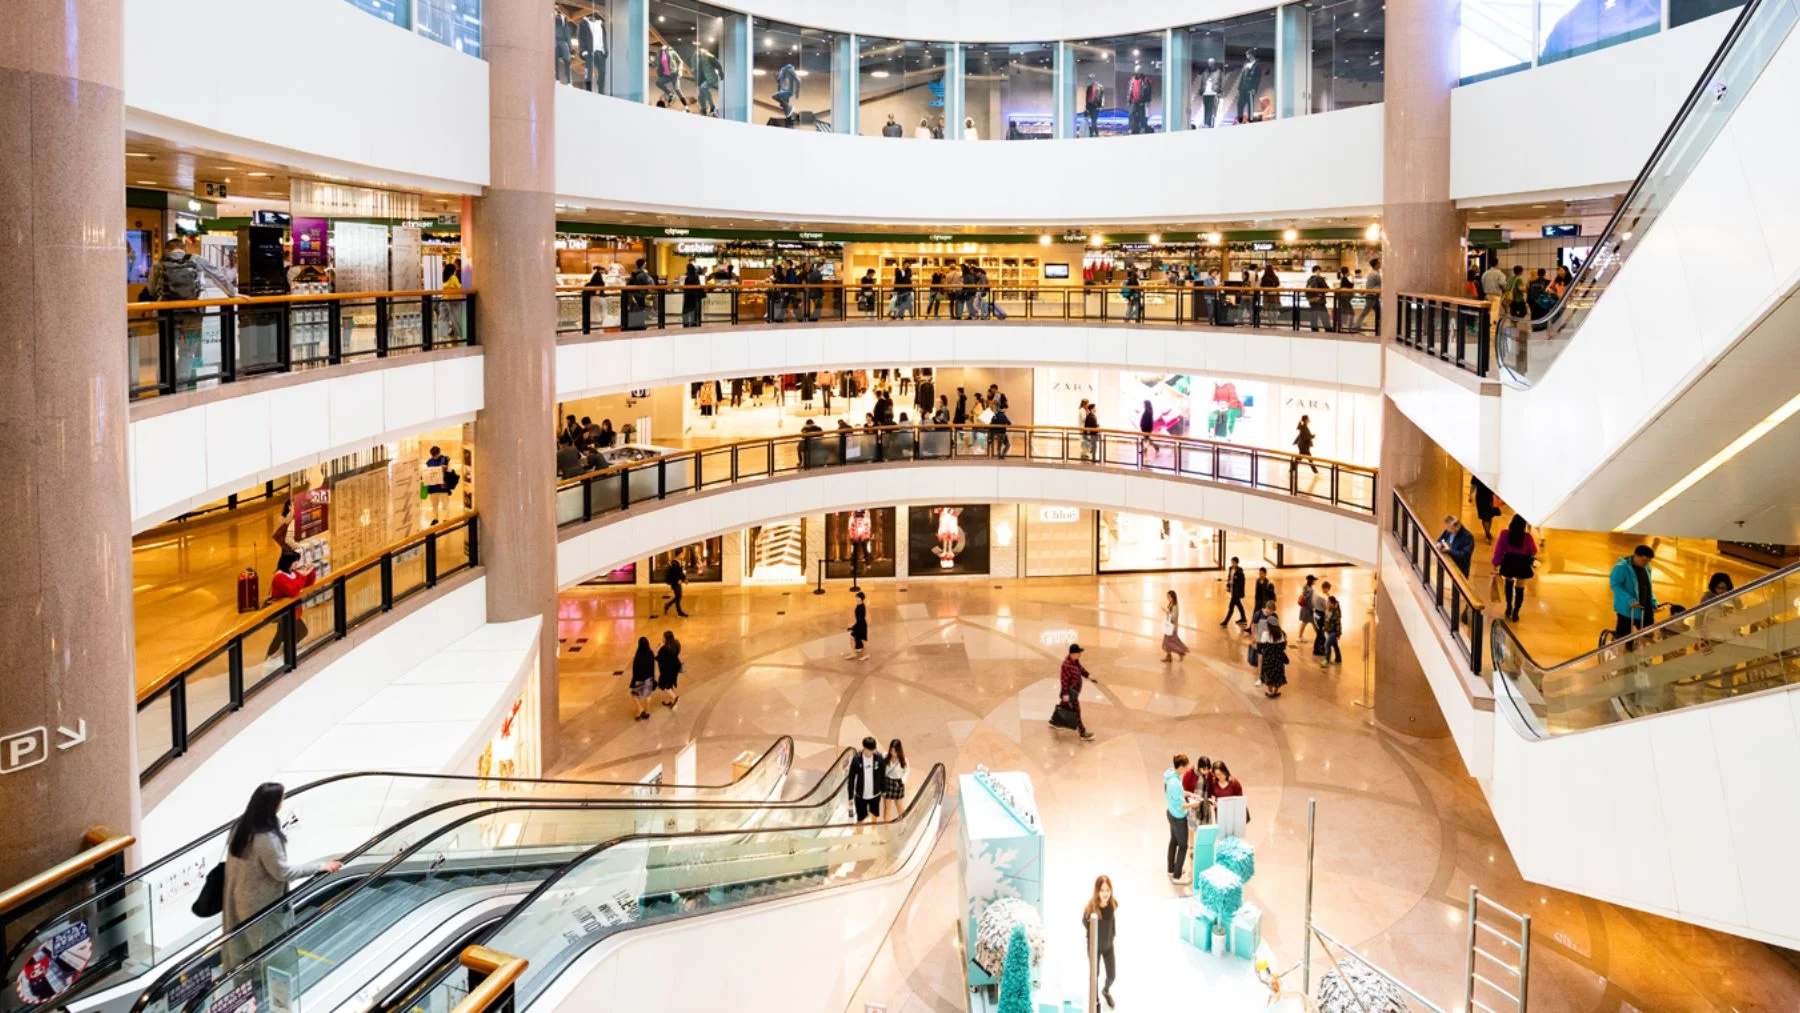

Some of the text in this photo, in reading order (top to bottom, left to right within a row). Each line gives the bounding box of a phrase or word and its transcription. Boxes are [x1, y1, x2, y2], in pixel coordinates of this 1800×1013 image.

[678, 242, 715, 253] Cashier
[1052, 382, 1093, 391] ZARA
[1285, 397, 1331, 410] ZARA
[10, 736, 37, 767] P
